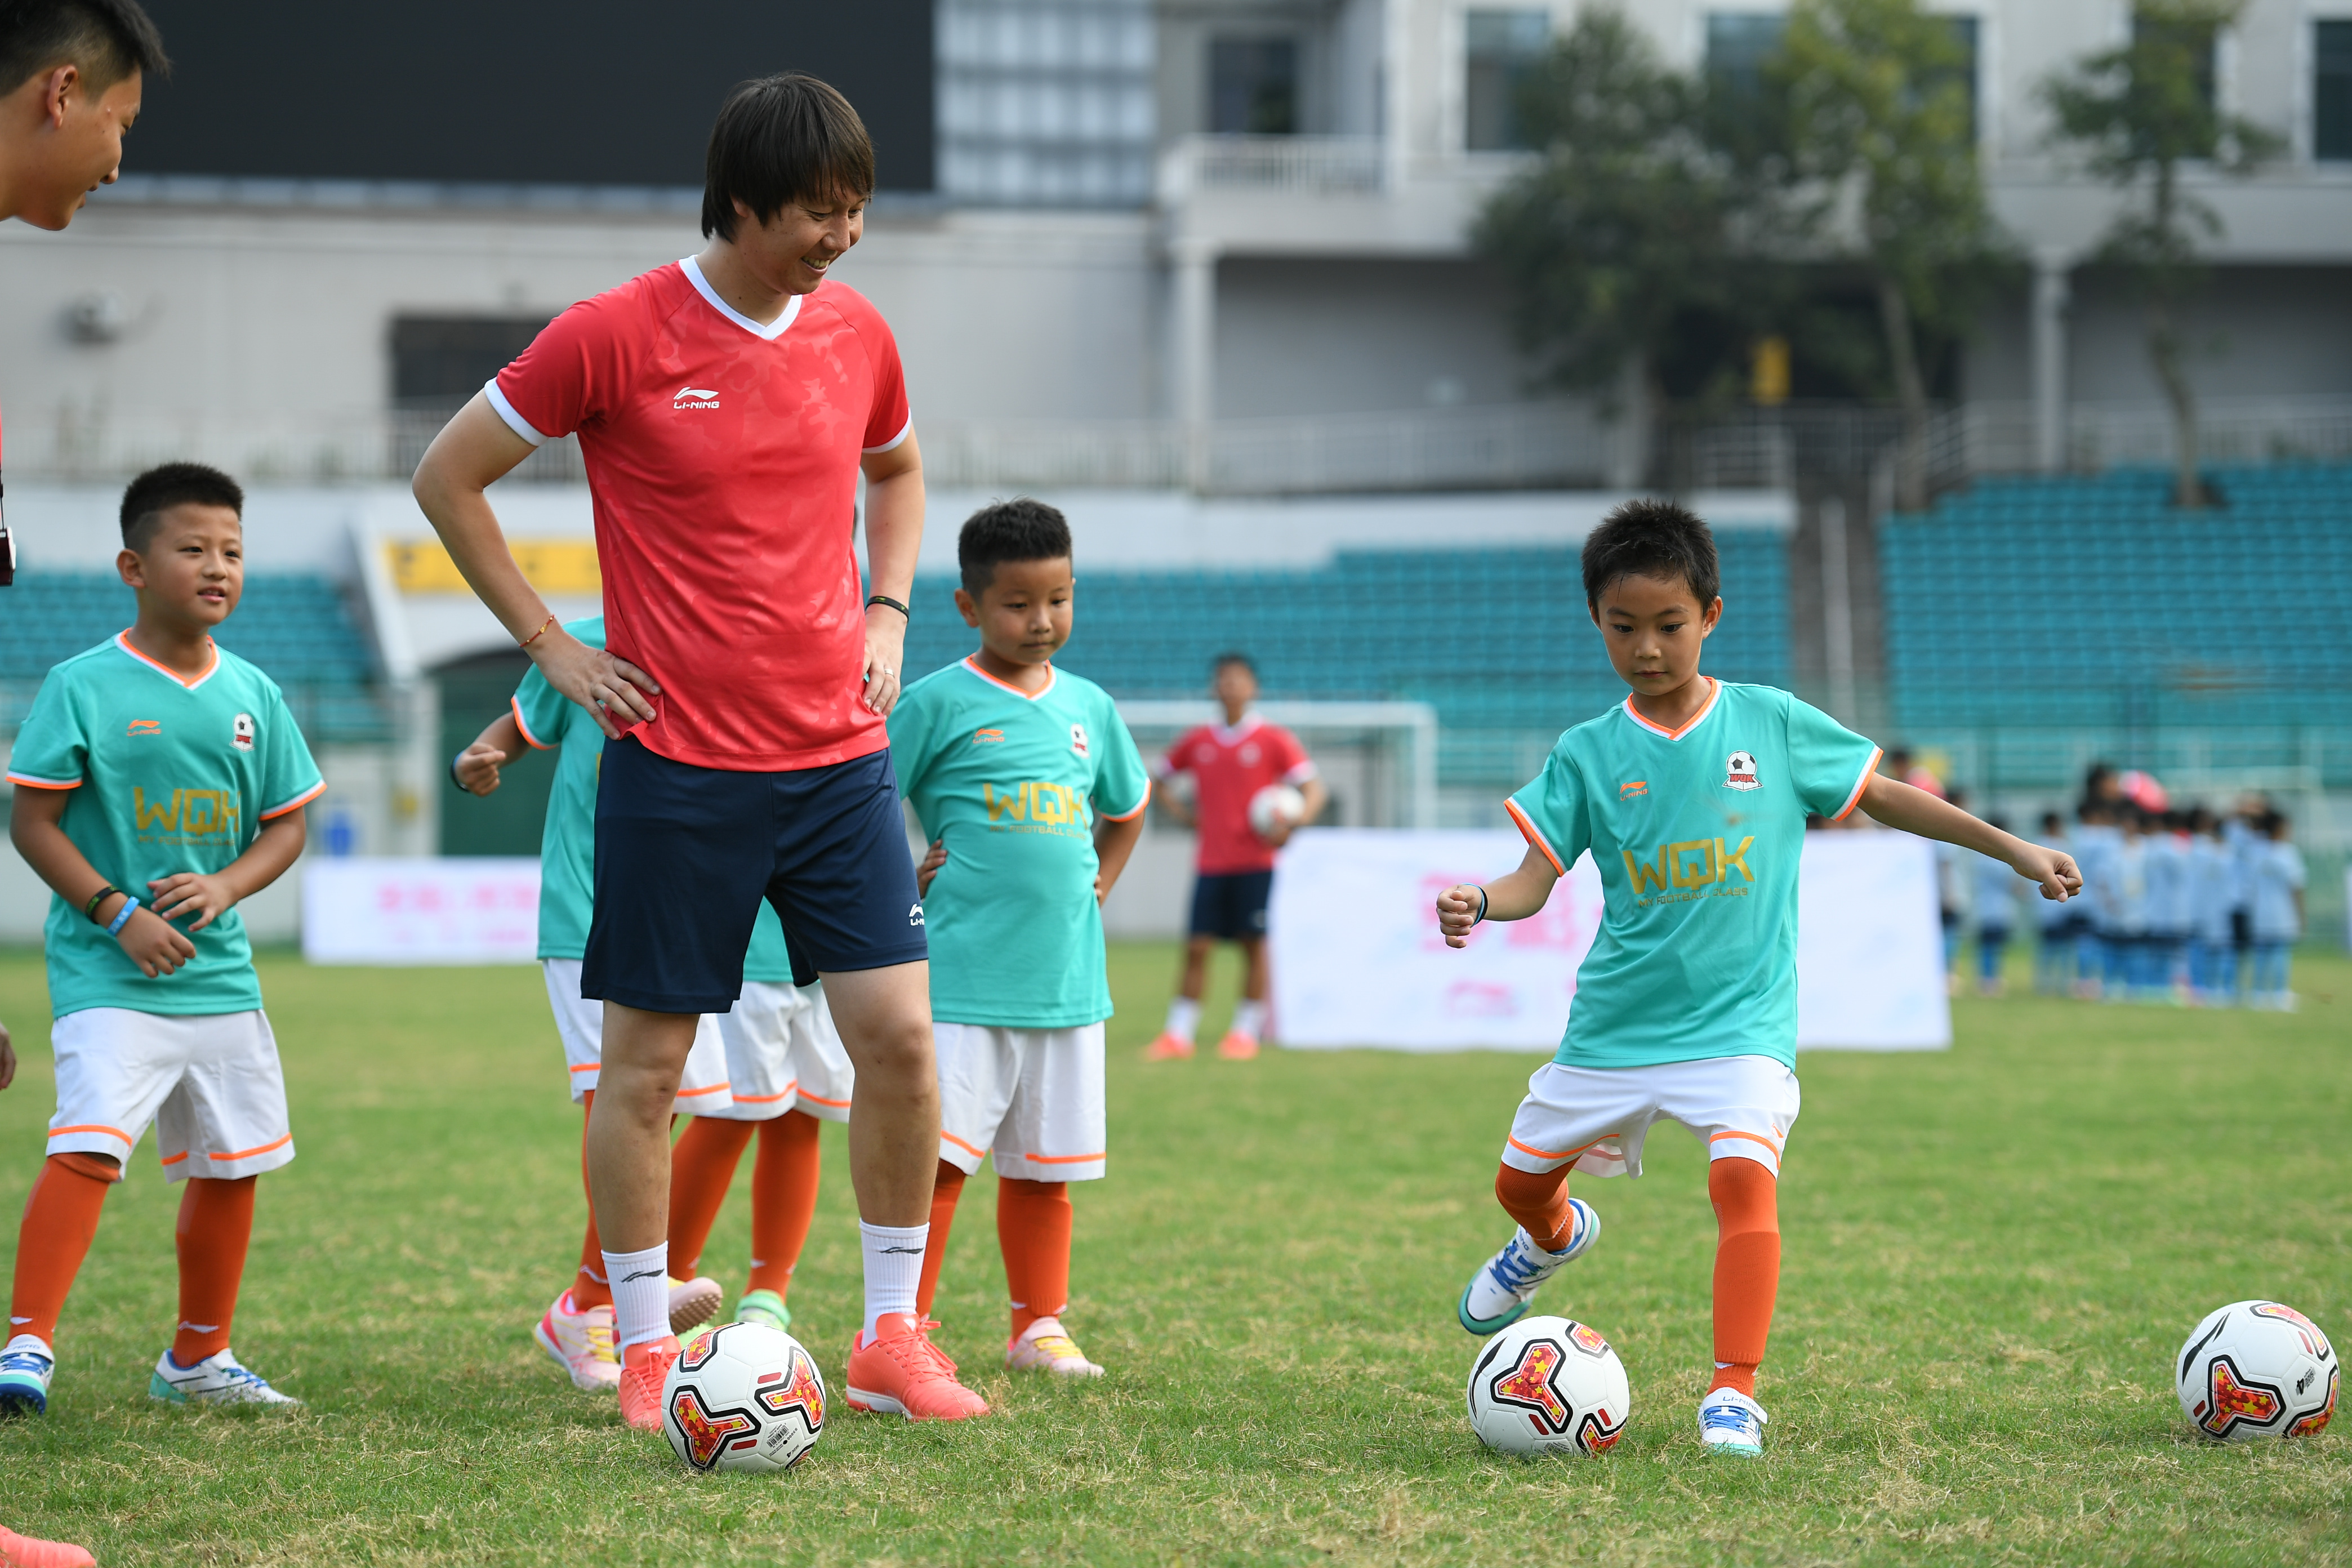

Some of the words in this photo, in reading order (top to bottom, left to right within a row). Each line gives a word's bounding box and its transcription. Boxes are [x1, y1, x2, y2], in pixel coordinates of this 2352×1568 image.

[673, 400, 720, 409] LI-NING
[1730, 774, 1755, 783] WQK
[1620, 788, 1649, 801] LI-NING
[983, 781, 1089, 831] WQK
[1009, 825, 1065, 836] FOOTBALL
[158, 835, 210, 847] FOOTBALL
[1622, 835, 1756, 894] WQK
[1638, 898, 1654, 908] MY
[1656, 889, 1710, 905] FOOTBALL
[1712, 887, 1748, 897] CLASS
[2296, 1377, 2305, 1396] 4
[1722, 1396, 1758, 1413] LI-NING
